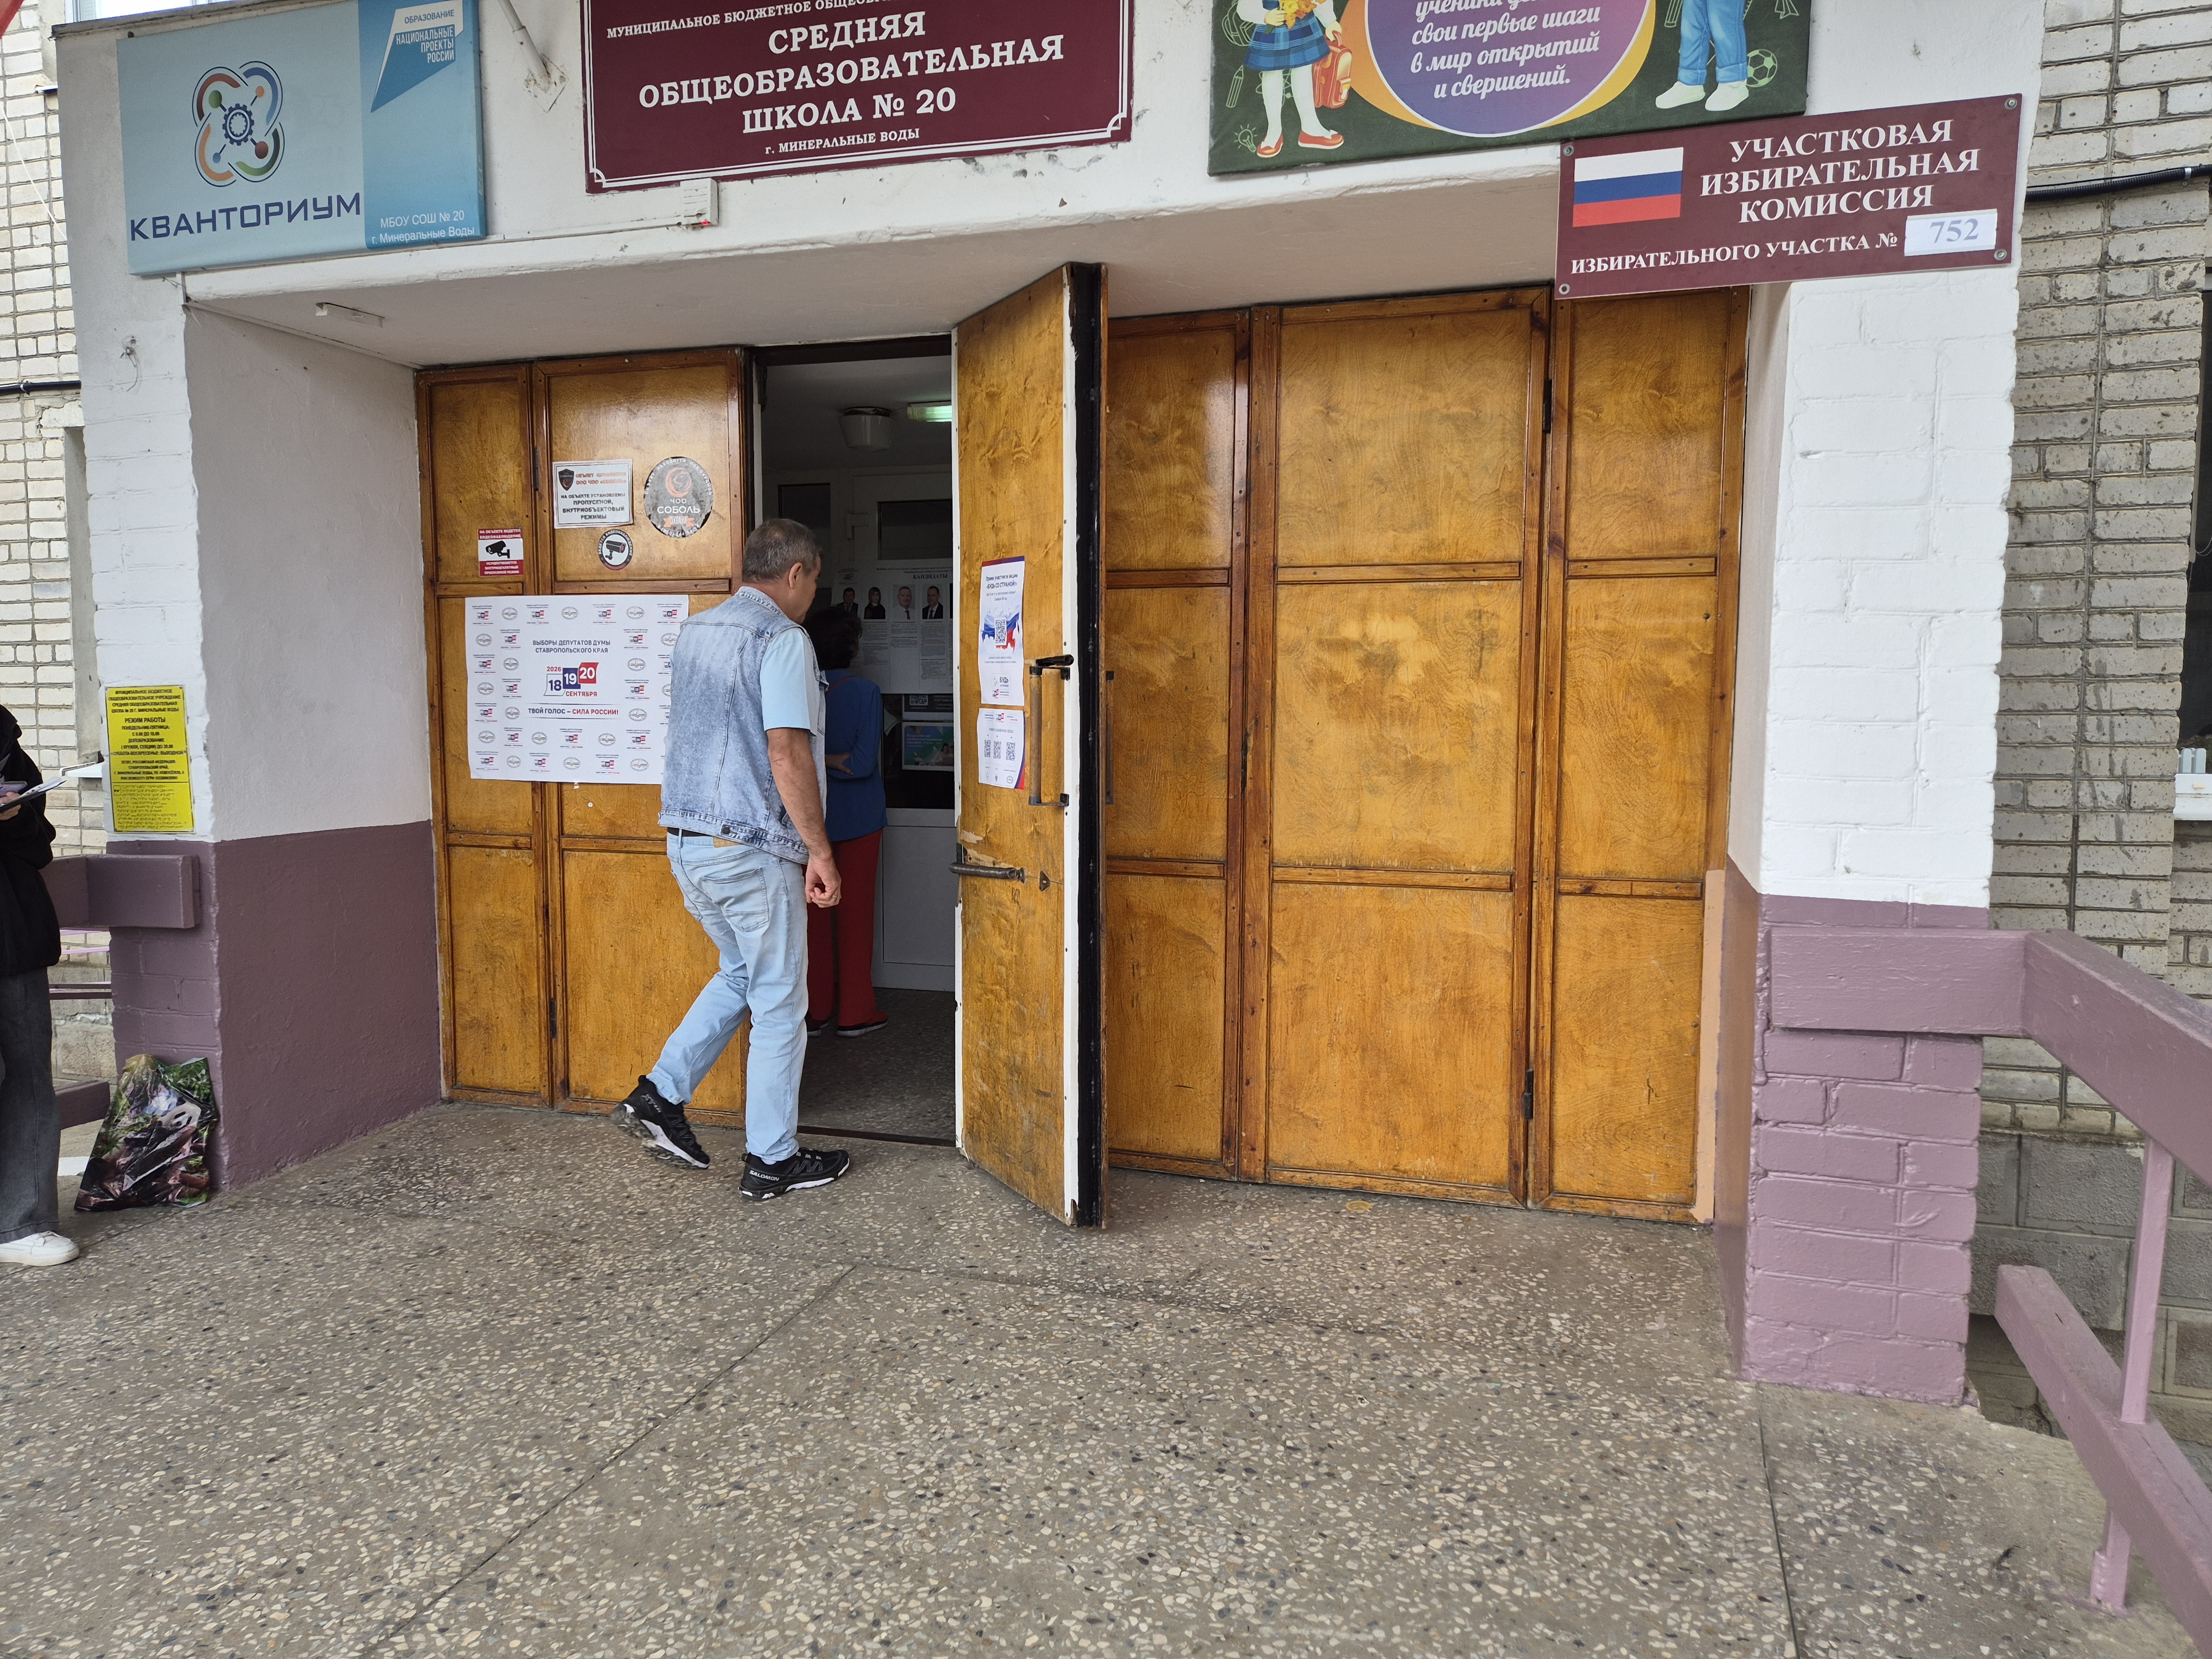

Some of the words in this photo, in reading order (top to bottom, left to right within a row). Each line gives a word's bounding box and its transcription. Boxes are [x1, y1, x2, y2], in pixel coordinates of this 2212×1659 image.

[405, 9, 454, 24] ОБРАЗОВАНИЕ
[607, 14, 721, 38] МУНИЦИПАЛЬНОЕ
[724, 1, 811, 23] БЮДЖЕТНОЕ
[769, 11, 925, 54] СРЕДНЯЯ
[1411, 22, 1457, 45] свои
[1461, 12, 1538, 43] первые
[1542, 7, 1600, 28] шаги
[396, 26, 453, 45] НАЦИОНАЛЬНЫЕ
[421, 39, 454, 53] ПРОЕКТЫ
[1410, 52, 1422, 73] в
[1426, 51, 1472, 74] мир
[1477, 30, 1600, 66] открытий
[427, 50, 454, 63] РОССИИ
[639, 34, 1064, 108] ОБЩЕОБРАЗОВАТЕЛЬНАЯ
[1433, 83, 1447, 98] и
[1451, 64, 1571, 100] свершений.
[742, 97, 862, 133] ШКОЛА
[873, 93, 905, 118] №
[916, 87, 956, 114] 20
[779, 132, 877, 154] МИНЕРАЛЬНЫЕ
[879, 128, 920, 143] ВОДЫ
[1730, 119, 1954, 163] УЧАСТКОВАЯ
[1700, 149, 1981, 196] ИЗБИРАТЕЛЬНАЯ
[131, 192, 360, 241] КВАНТОРИУМ
[380, 216, 409, 228] МБОУ
[412, 213, 436, 225] СОШ
[439, 212, 450, 222] №
[453, 210, 465, 221] 20
[1739, 185, 1934, 223] КОМИССИЯ
[380, 229, 445, 243] Минеральные
[448, 227, 474, 237] Воды
[1571, 243, 1760, 274] ИЗБИРАТЕЛЬНОГО
[1767, 234, 1868, 257] УЧАСТКА
[1875, 232, 1897, 248] №
[1931, 218, 1980, 244] 752
[657, 505, 700, 514] СОБОЛЬ
[549, 680, 562, 691] 18
[564, 672, 577, 685] 19
[579, 667, 595, 679] 20
[749, 1170, 780, 1181] SALOMON
